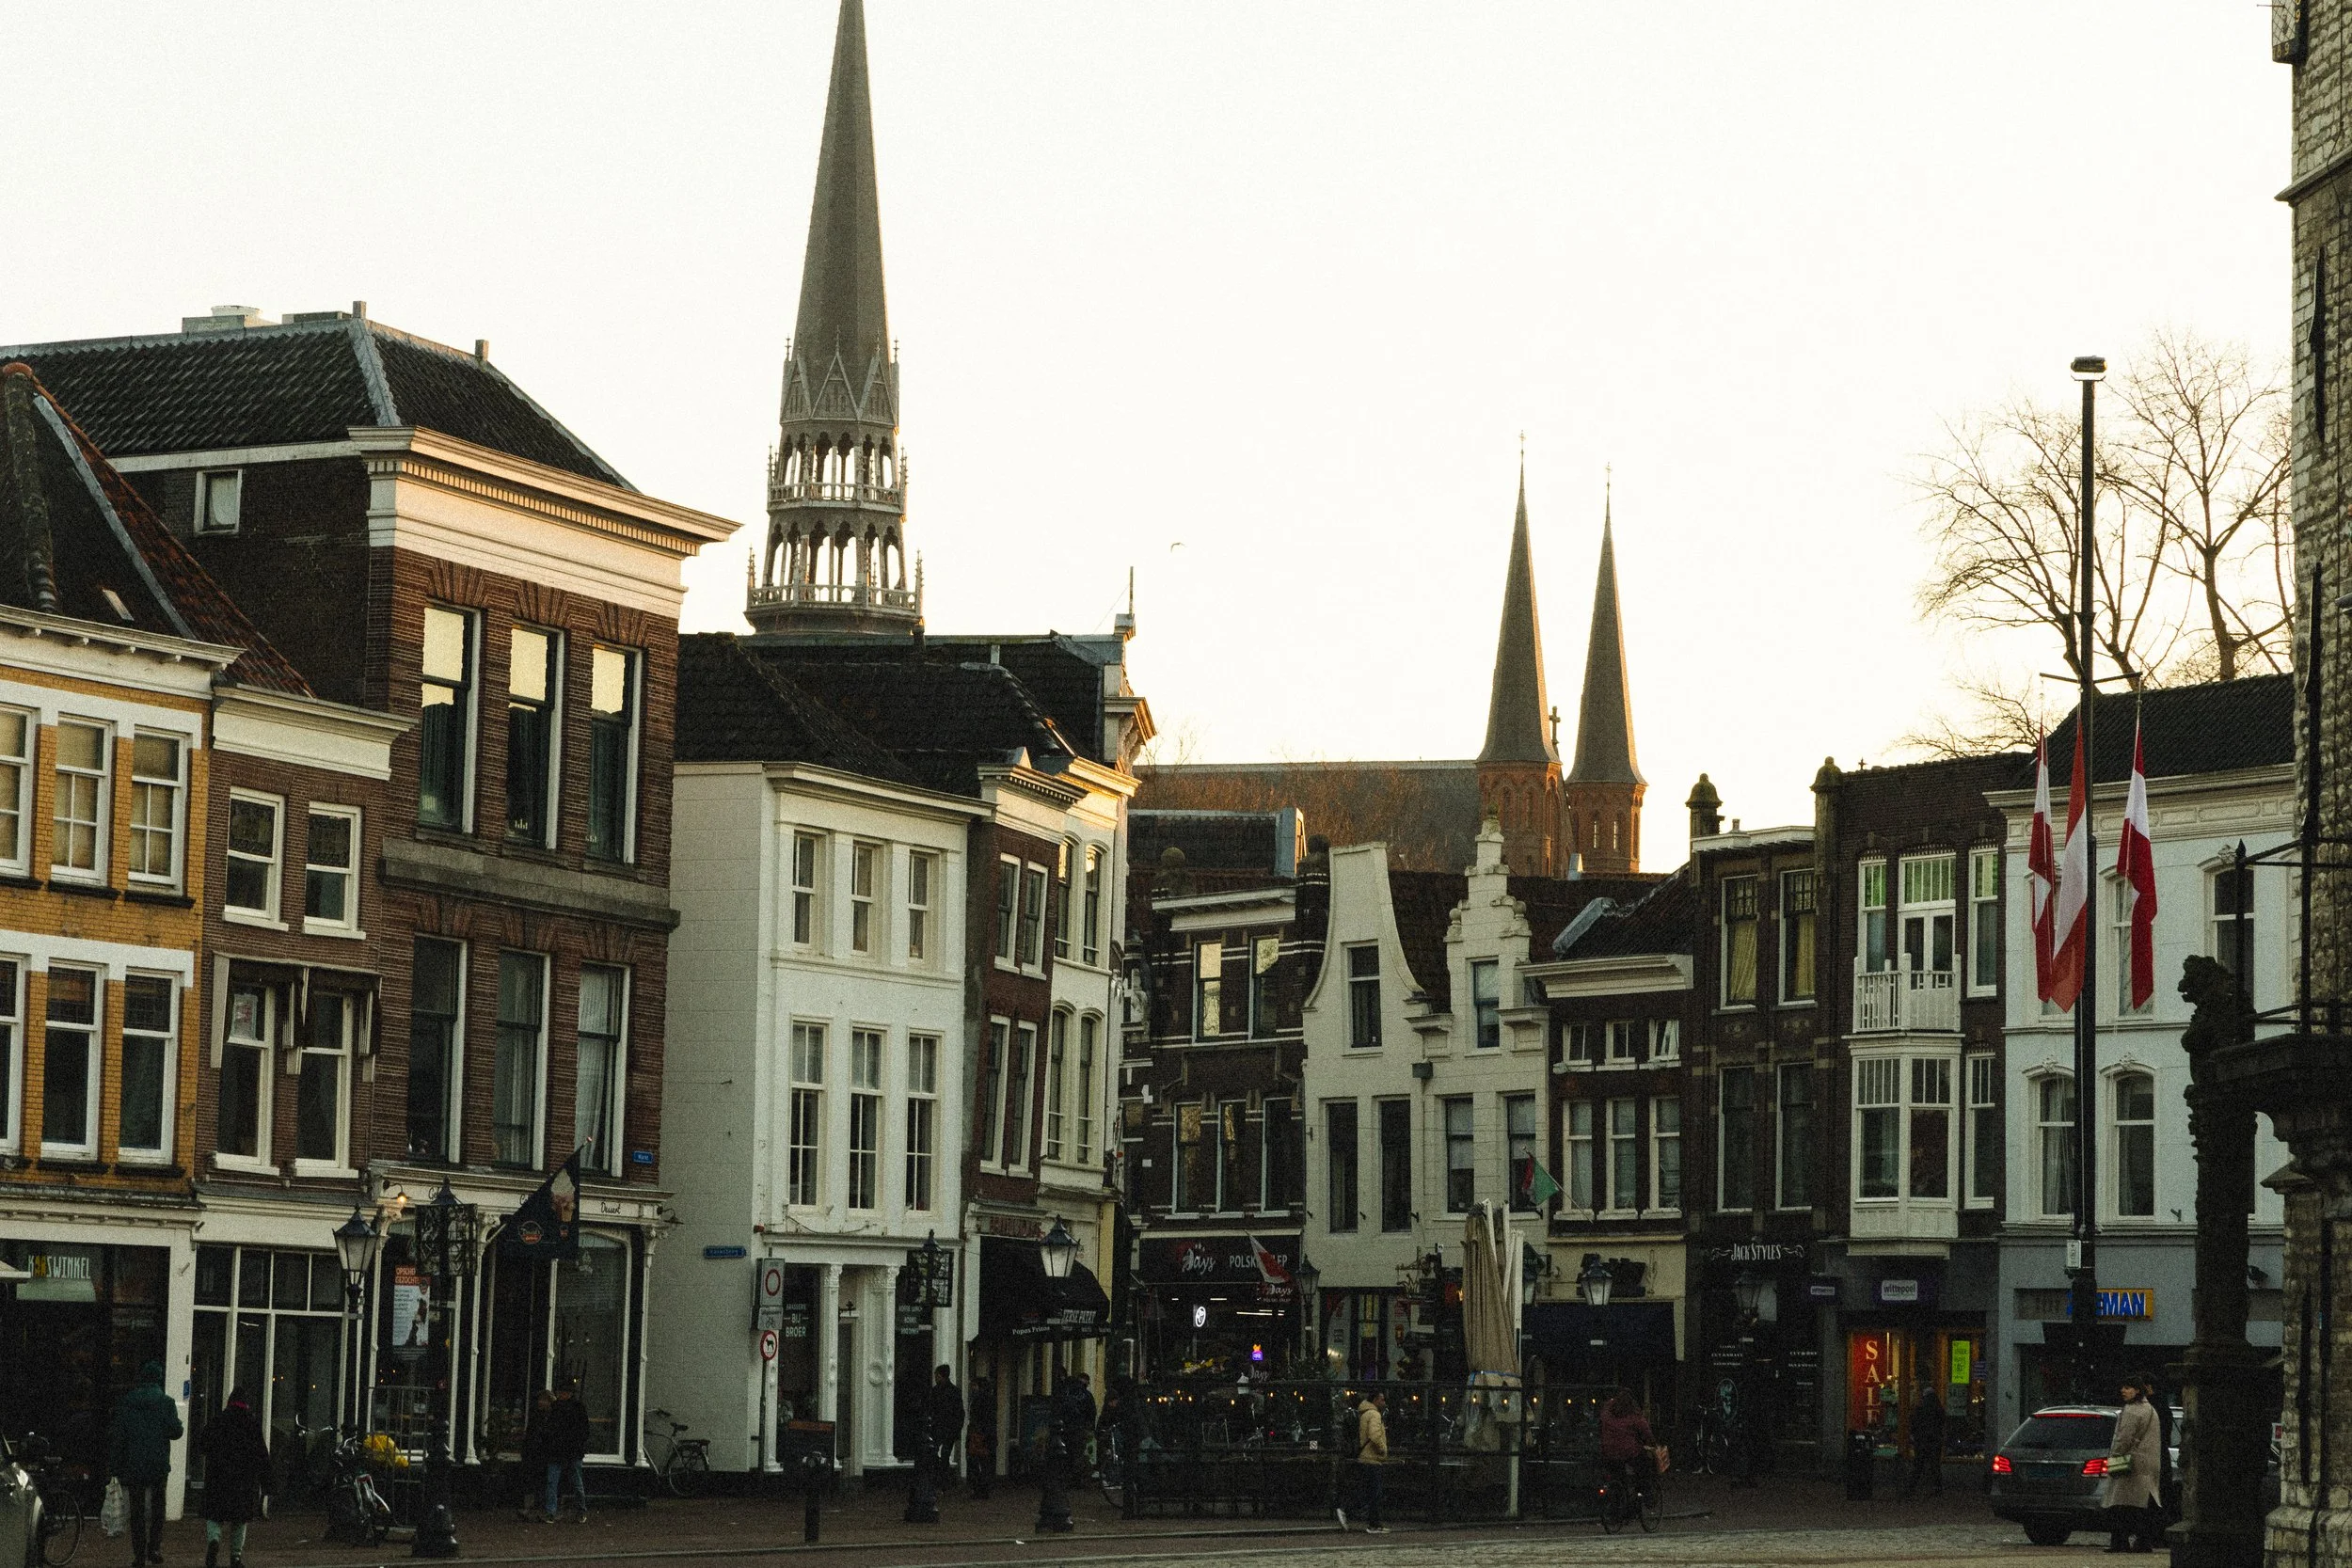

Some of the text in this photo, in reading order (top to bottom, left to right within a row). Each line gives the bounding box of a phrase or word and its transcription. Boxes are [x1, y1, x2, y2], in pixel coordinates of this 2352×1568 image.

[1730, 1243, 1782, 1261] JACK STYLES
[1229, 1255, 1258, 1269] POLSK
[1883, 1283, 1916, 1295] wittepoel
[786, 1326, 806, 1338] BROER
[1865, 1339, 1883, 1425] SALE
